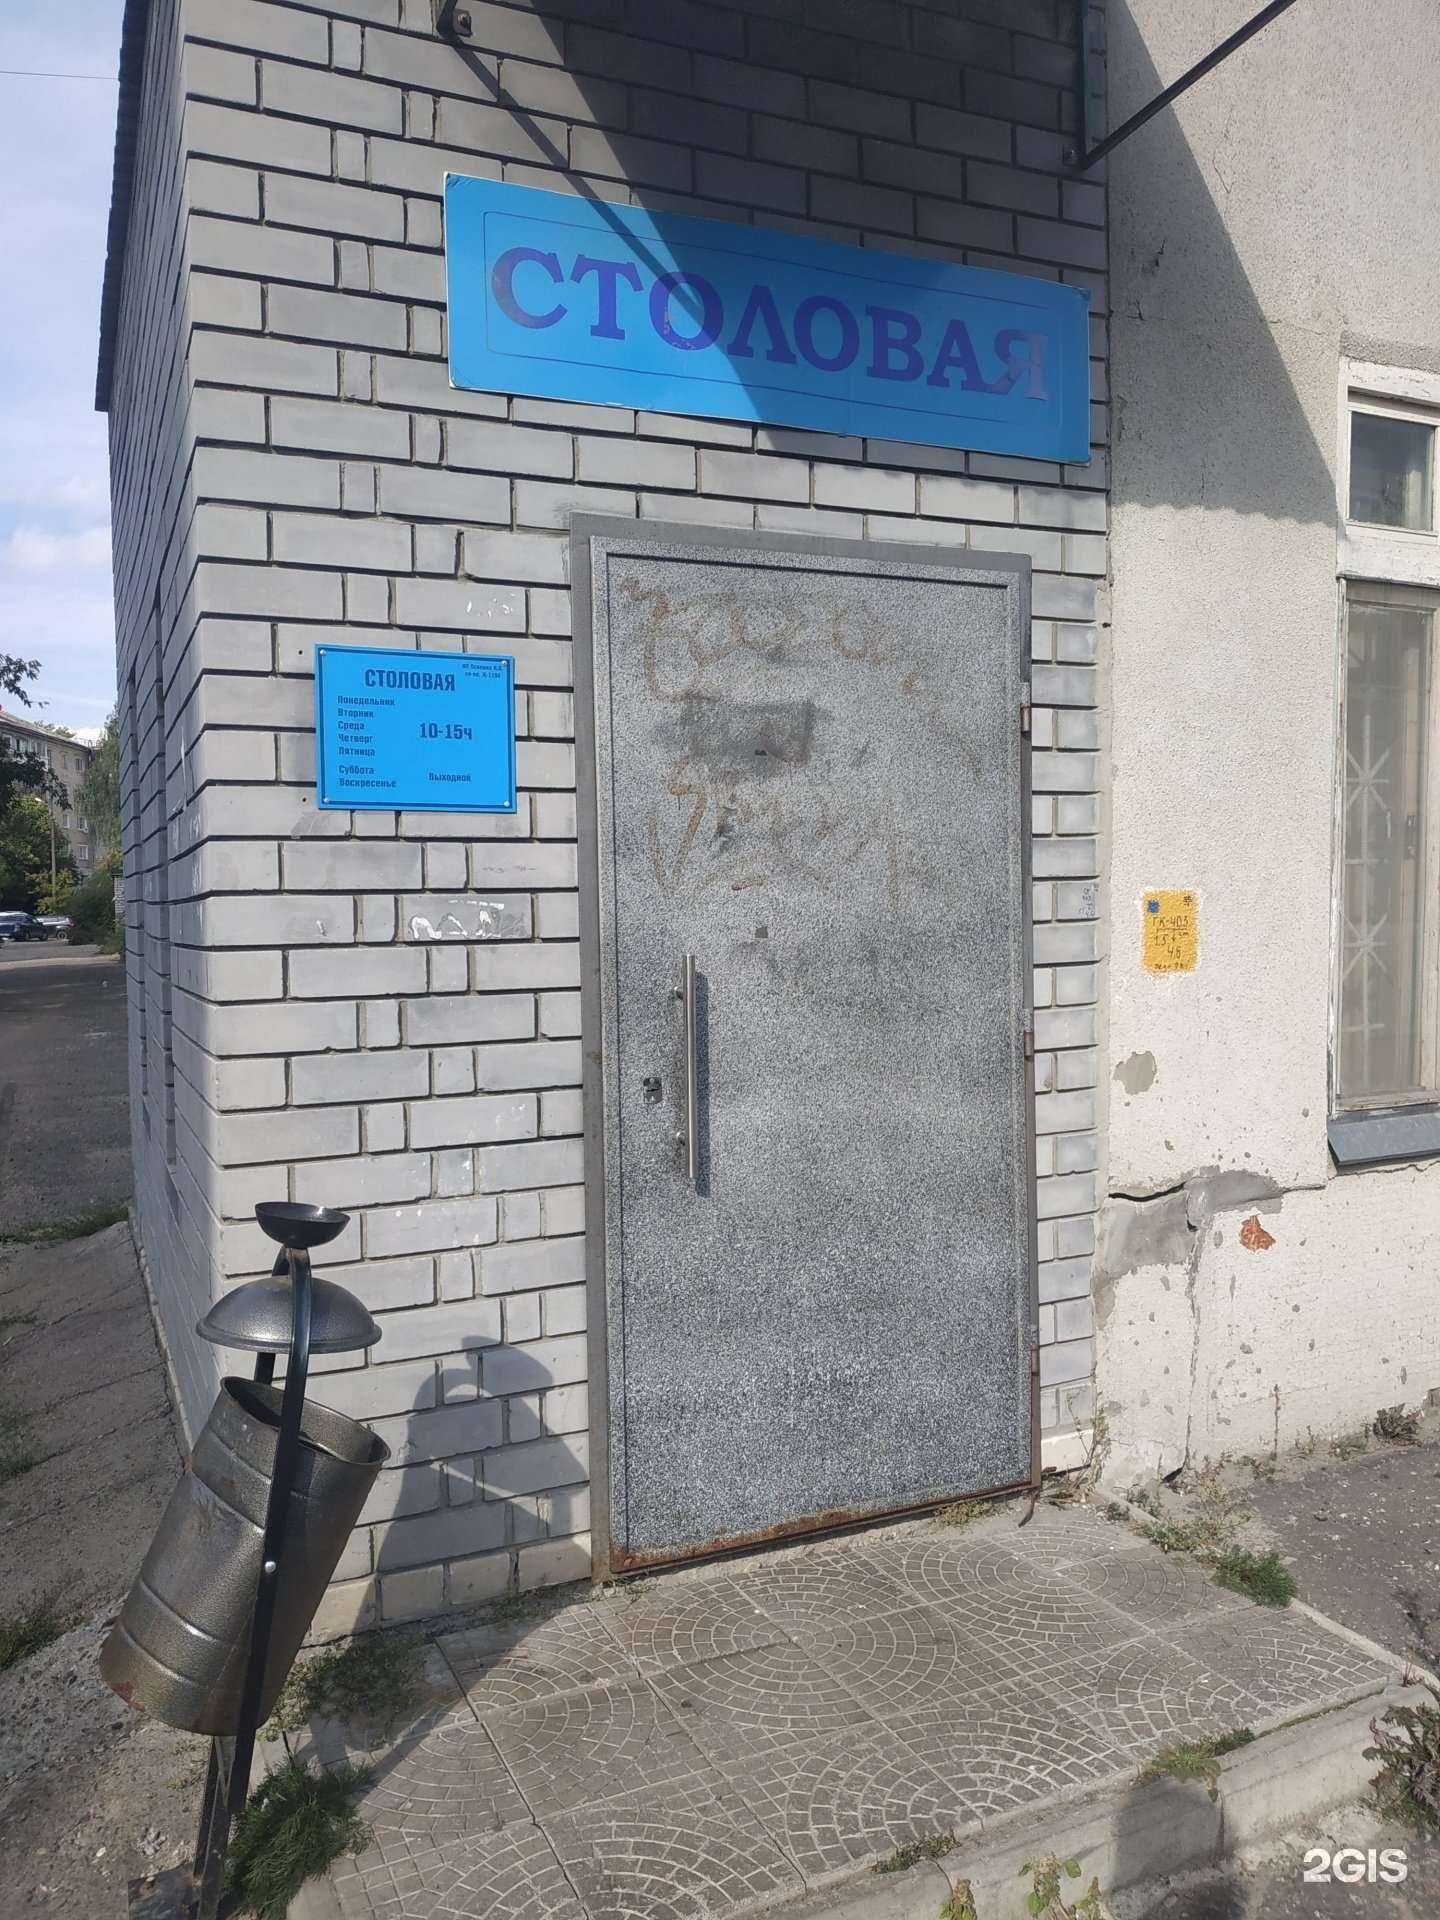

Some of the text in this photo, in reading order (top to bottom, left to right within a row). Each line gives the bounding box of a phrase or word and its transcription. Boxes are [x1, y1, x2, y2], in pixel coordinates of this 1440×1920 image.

[491, 246, 1049, 402] СТОЛОВАЯ
[365, 669, 455, 691] СТОЛОВАЯ
[338, 695, 395, 706] Понедельник
[338, 708, 374, 718] Вторник
[338, 721, 365, 731] Среда
[419, 723, 473, 740] 10-15ч
[338, 734, 373, 743] Четверг
[339, 747, 375, 757] Пятница
[339, 765, 375, 775] Суббота
[429, 772, 471, 782] Выходной
[339, 778, 397, 788] Воскресенье
